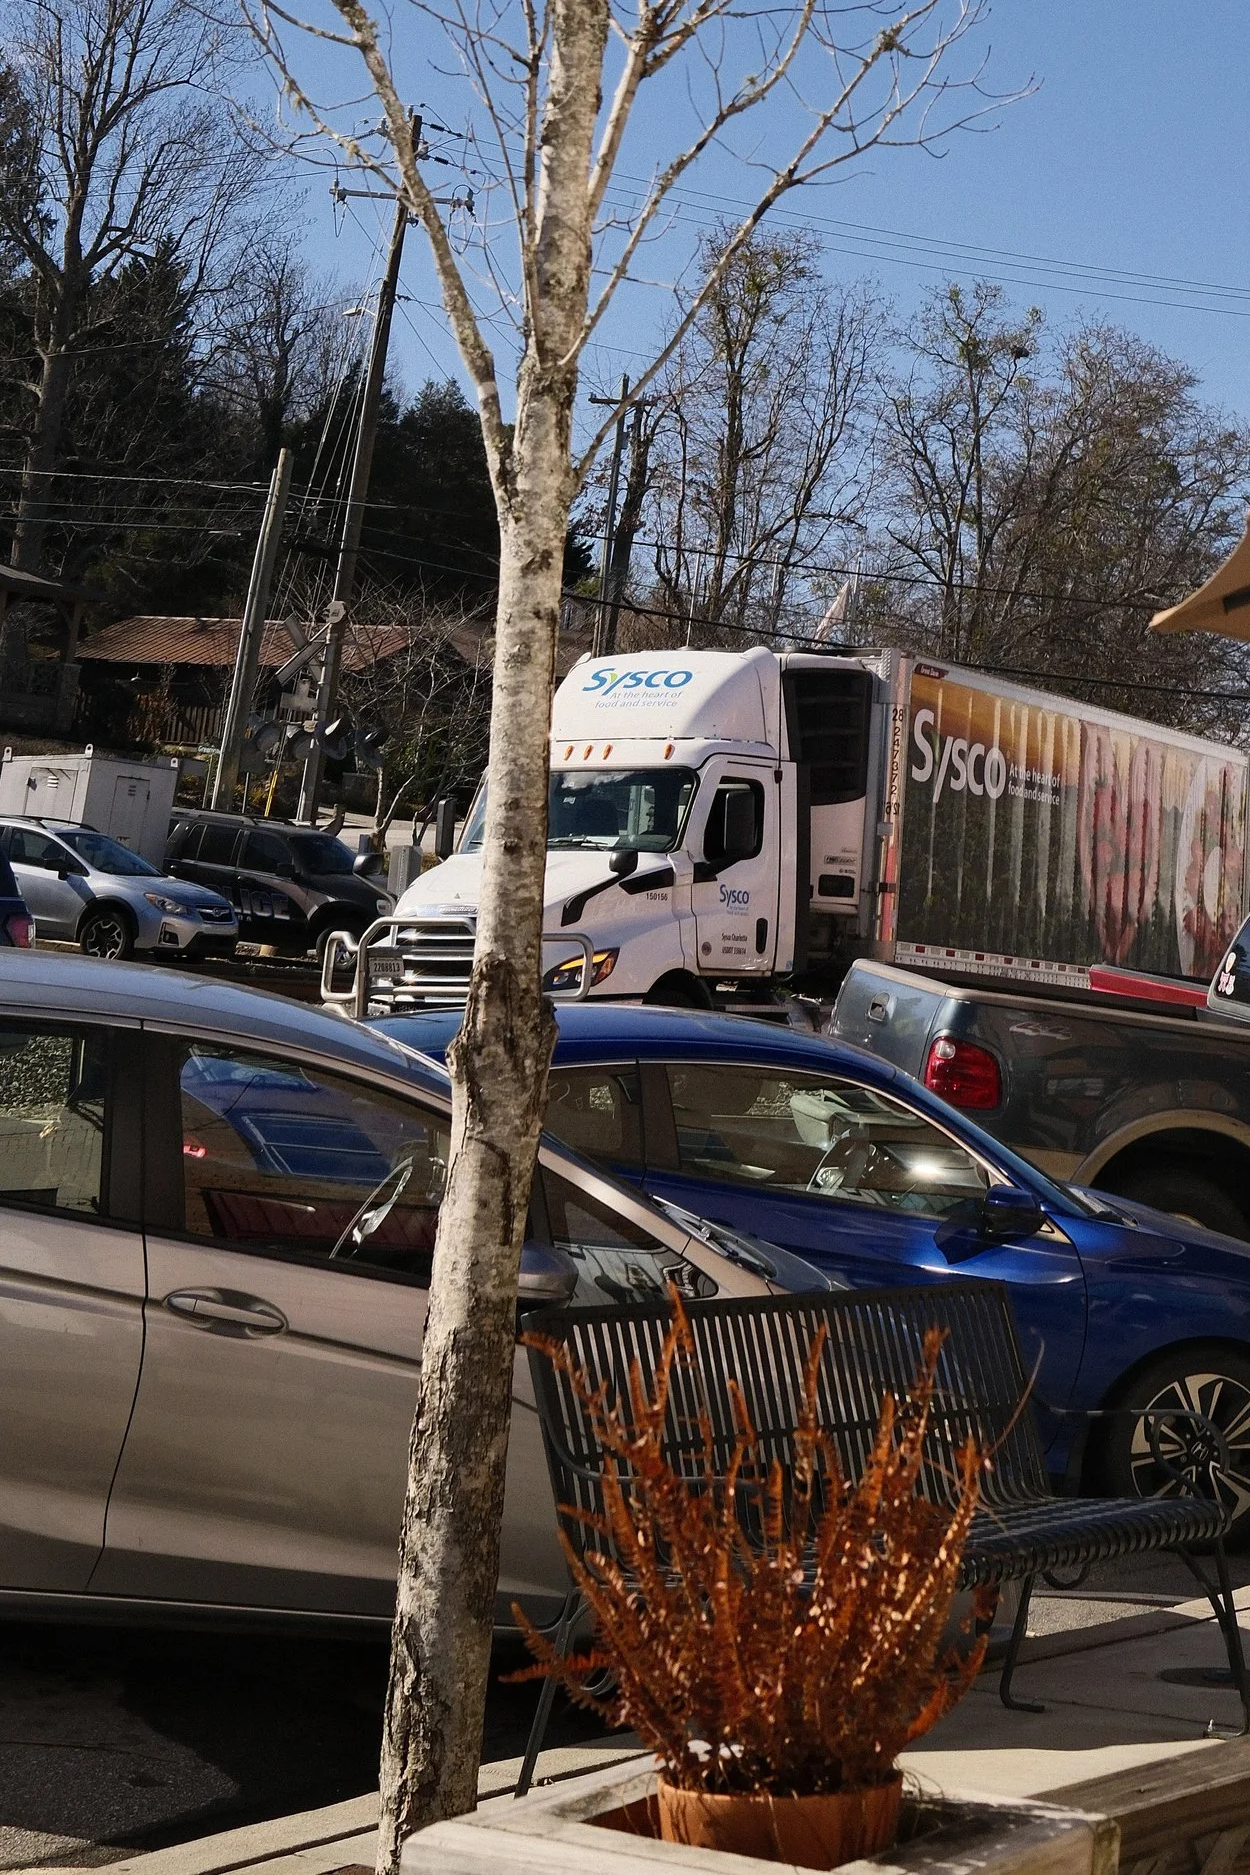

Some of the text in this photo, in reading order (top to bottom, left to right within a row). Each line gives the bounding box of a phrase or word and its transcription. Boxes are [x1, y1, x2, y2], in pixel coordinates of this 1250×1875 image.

[623, 691, 640, 699] the
[641, 691, 668, 699] heart
[670, 691, 682, 699] of
[595, 700, 678, 709] food and service
[892, 708, 904, 722] 28
[1018, 765, 1031, 781] the
[1032, 768, 1052, 787] heart
[1051, 773, 1061, 789] of
[1008, 781, 1060, 806] food and service
[720, 884, 750, 907] Sysco
